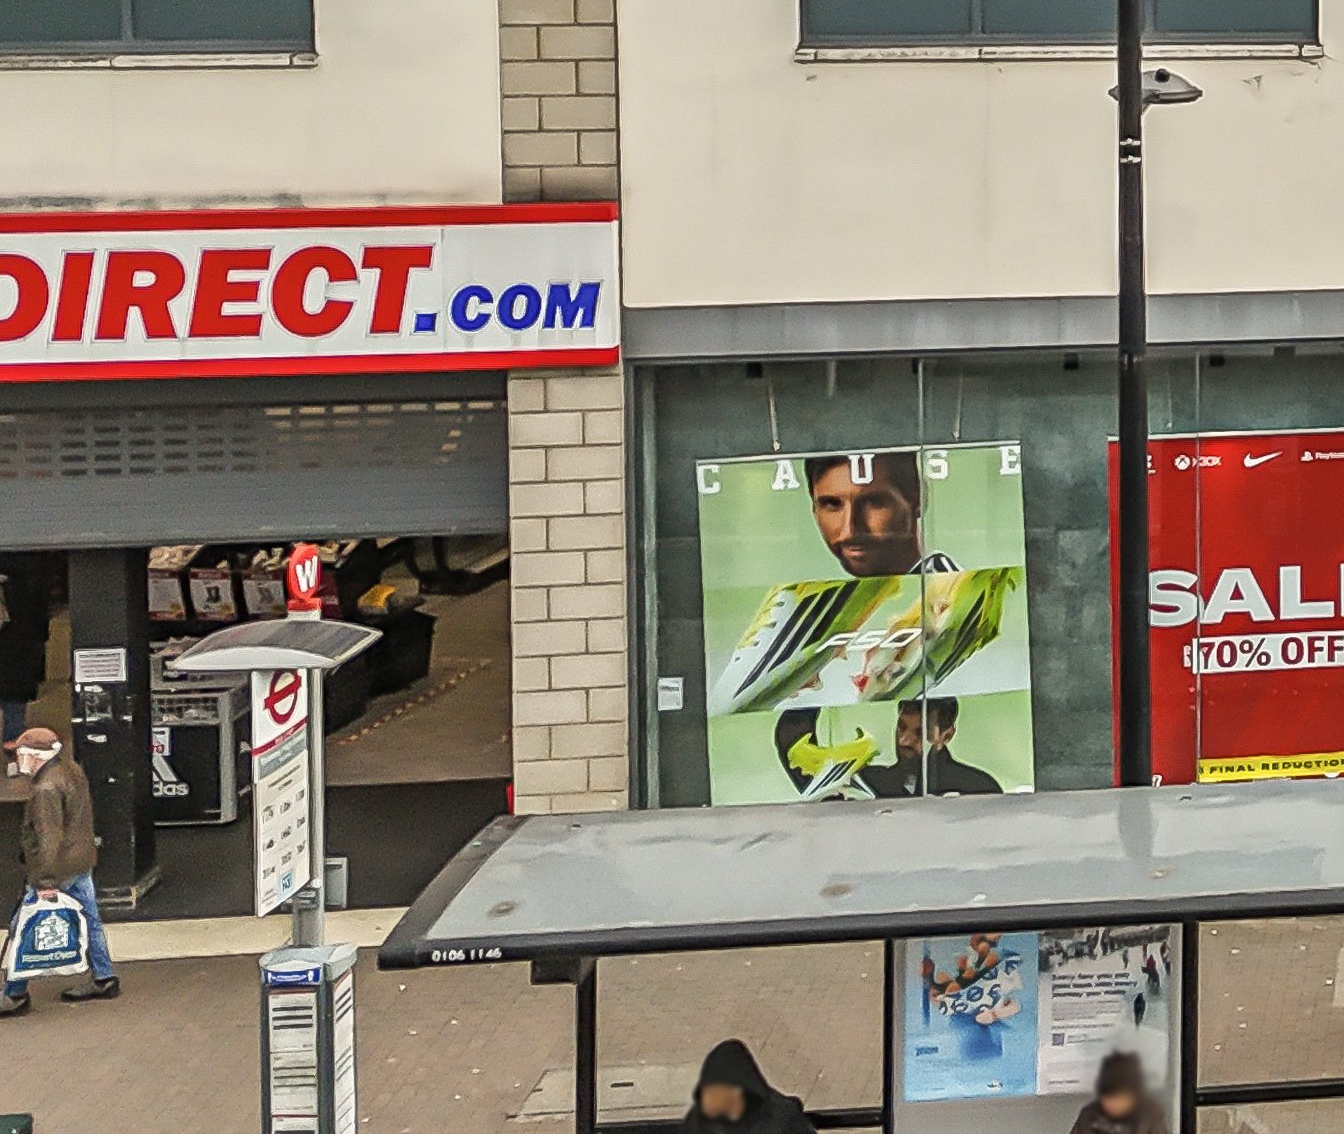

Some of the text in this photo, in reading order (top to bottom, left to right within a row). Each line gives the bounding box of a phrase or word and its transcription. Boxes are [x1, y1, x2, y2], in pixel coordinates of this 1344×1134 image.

[296, 555, 318, 593] W
[1200, 635, 1344, 669] 70% OFF
[1209, 763, 1255, 774] FINAL
[431, 949, 466, 962] 0106
